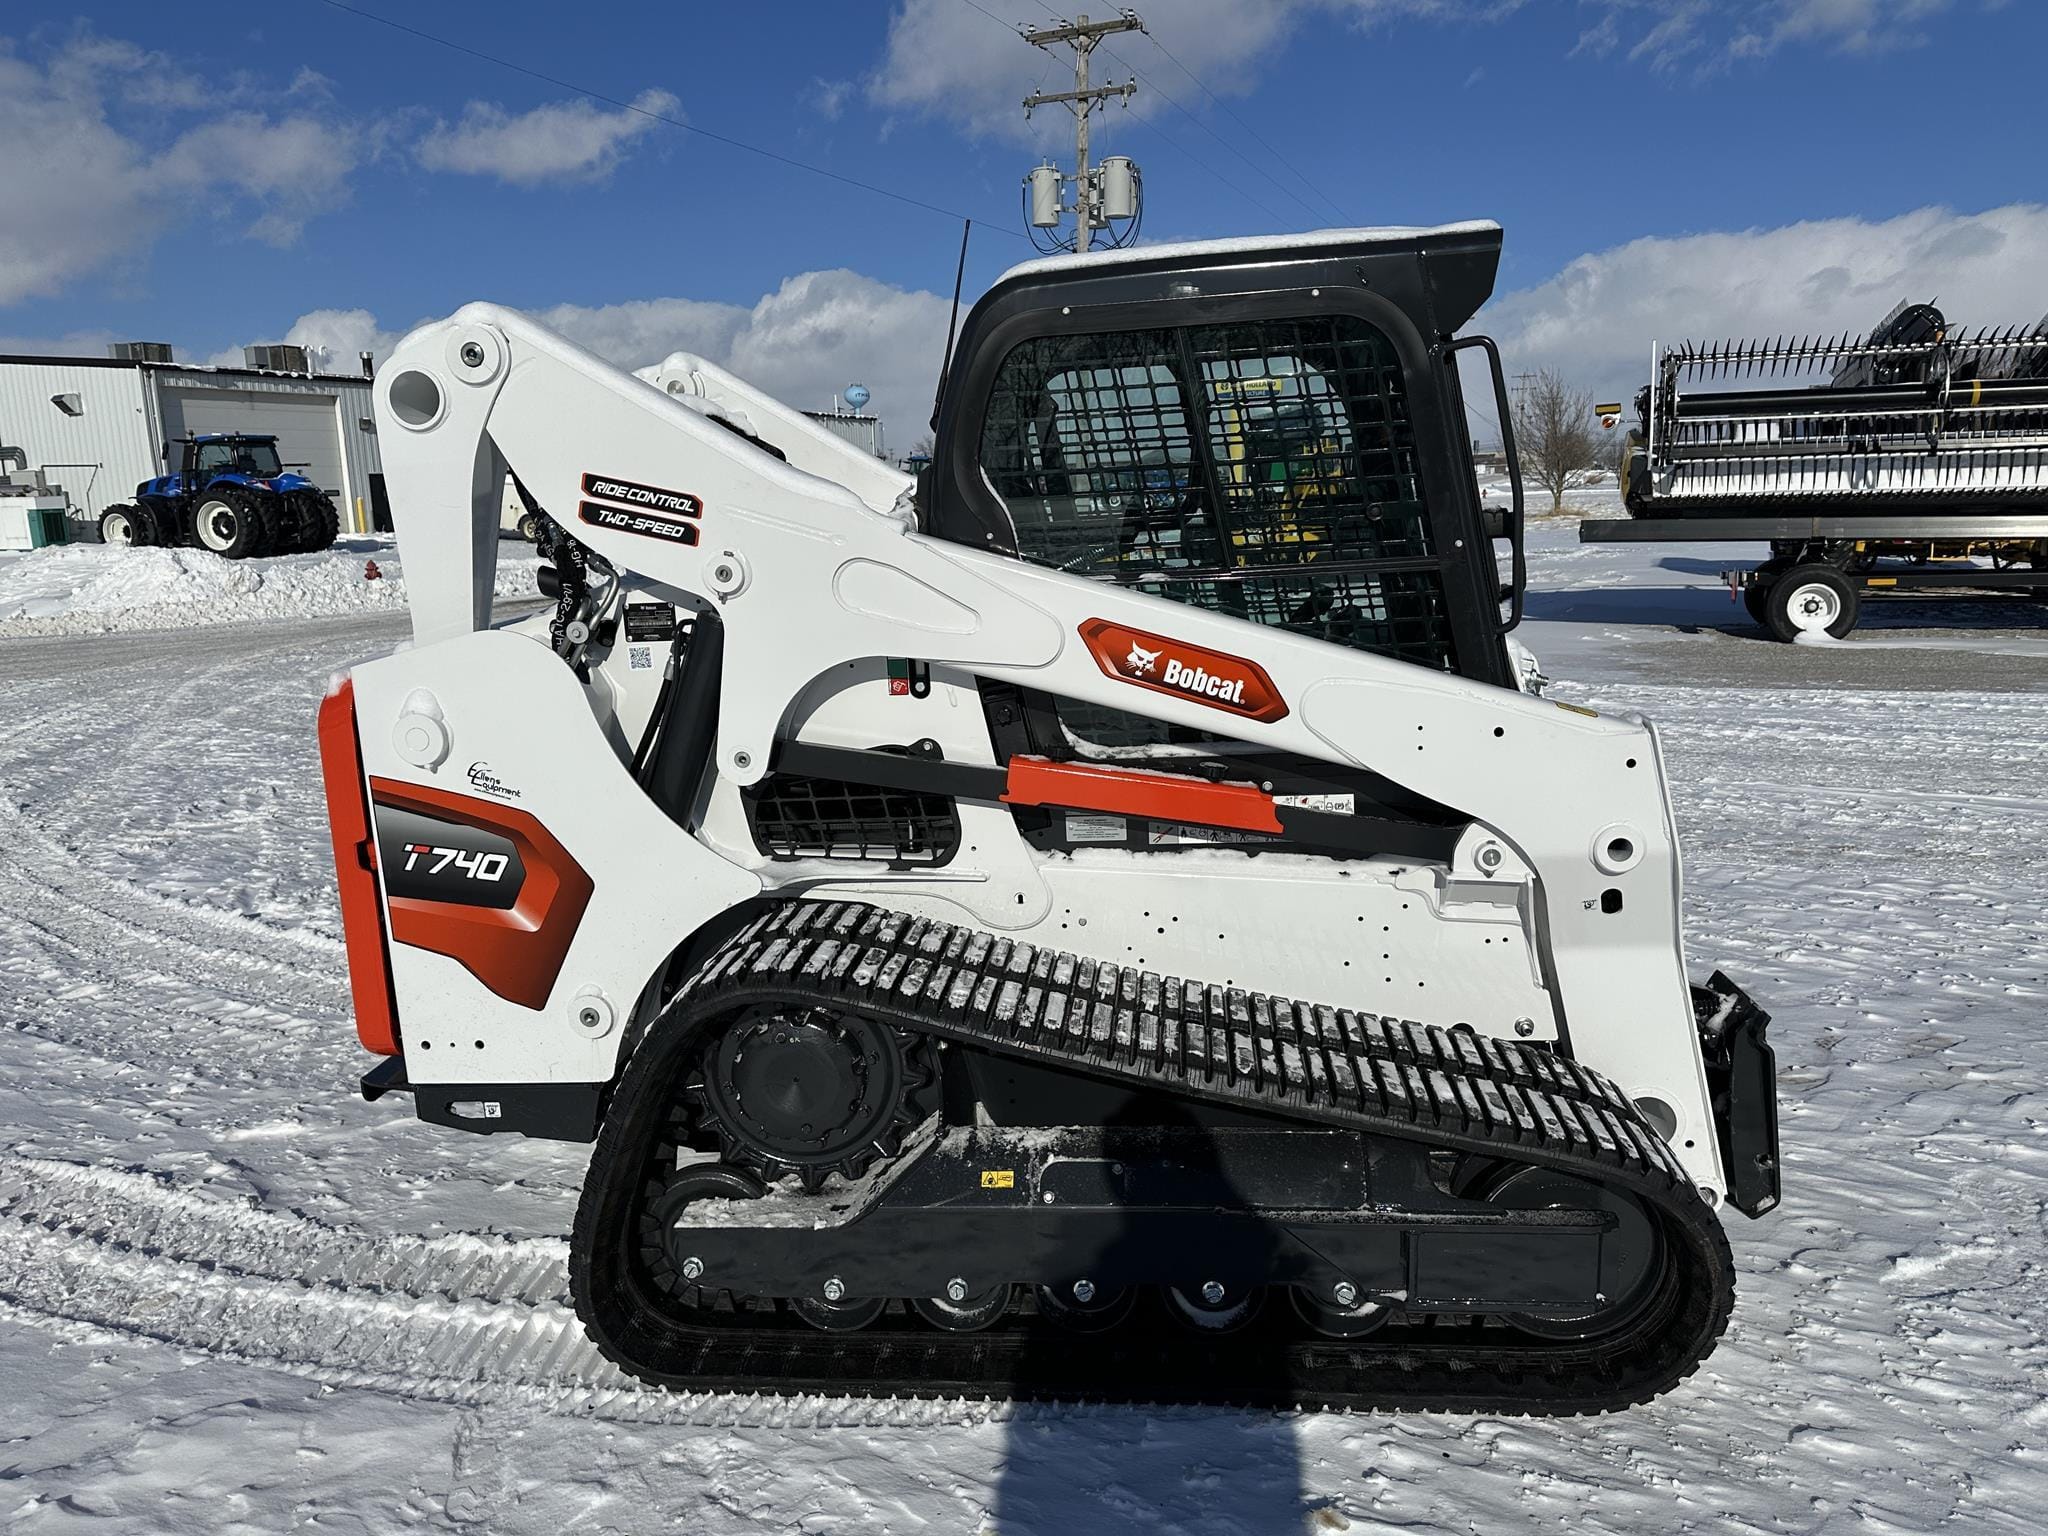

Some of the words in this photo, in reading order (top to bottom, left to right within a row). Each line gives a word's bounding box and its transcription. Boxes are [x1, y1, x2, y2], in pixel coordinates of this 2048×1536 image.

[592, 481, 629, 498] RIDE
[627, 488, 695, 512] CONTROL
[598, 510, 685, 538] TWO-SPEED
[1163, 658, 1244, 703] Bobcat
[404, 843, 509, 882] T740
